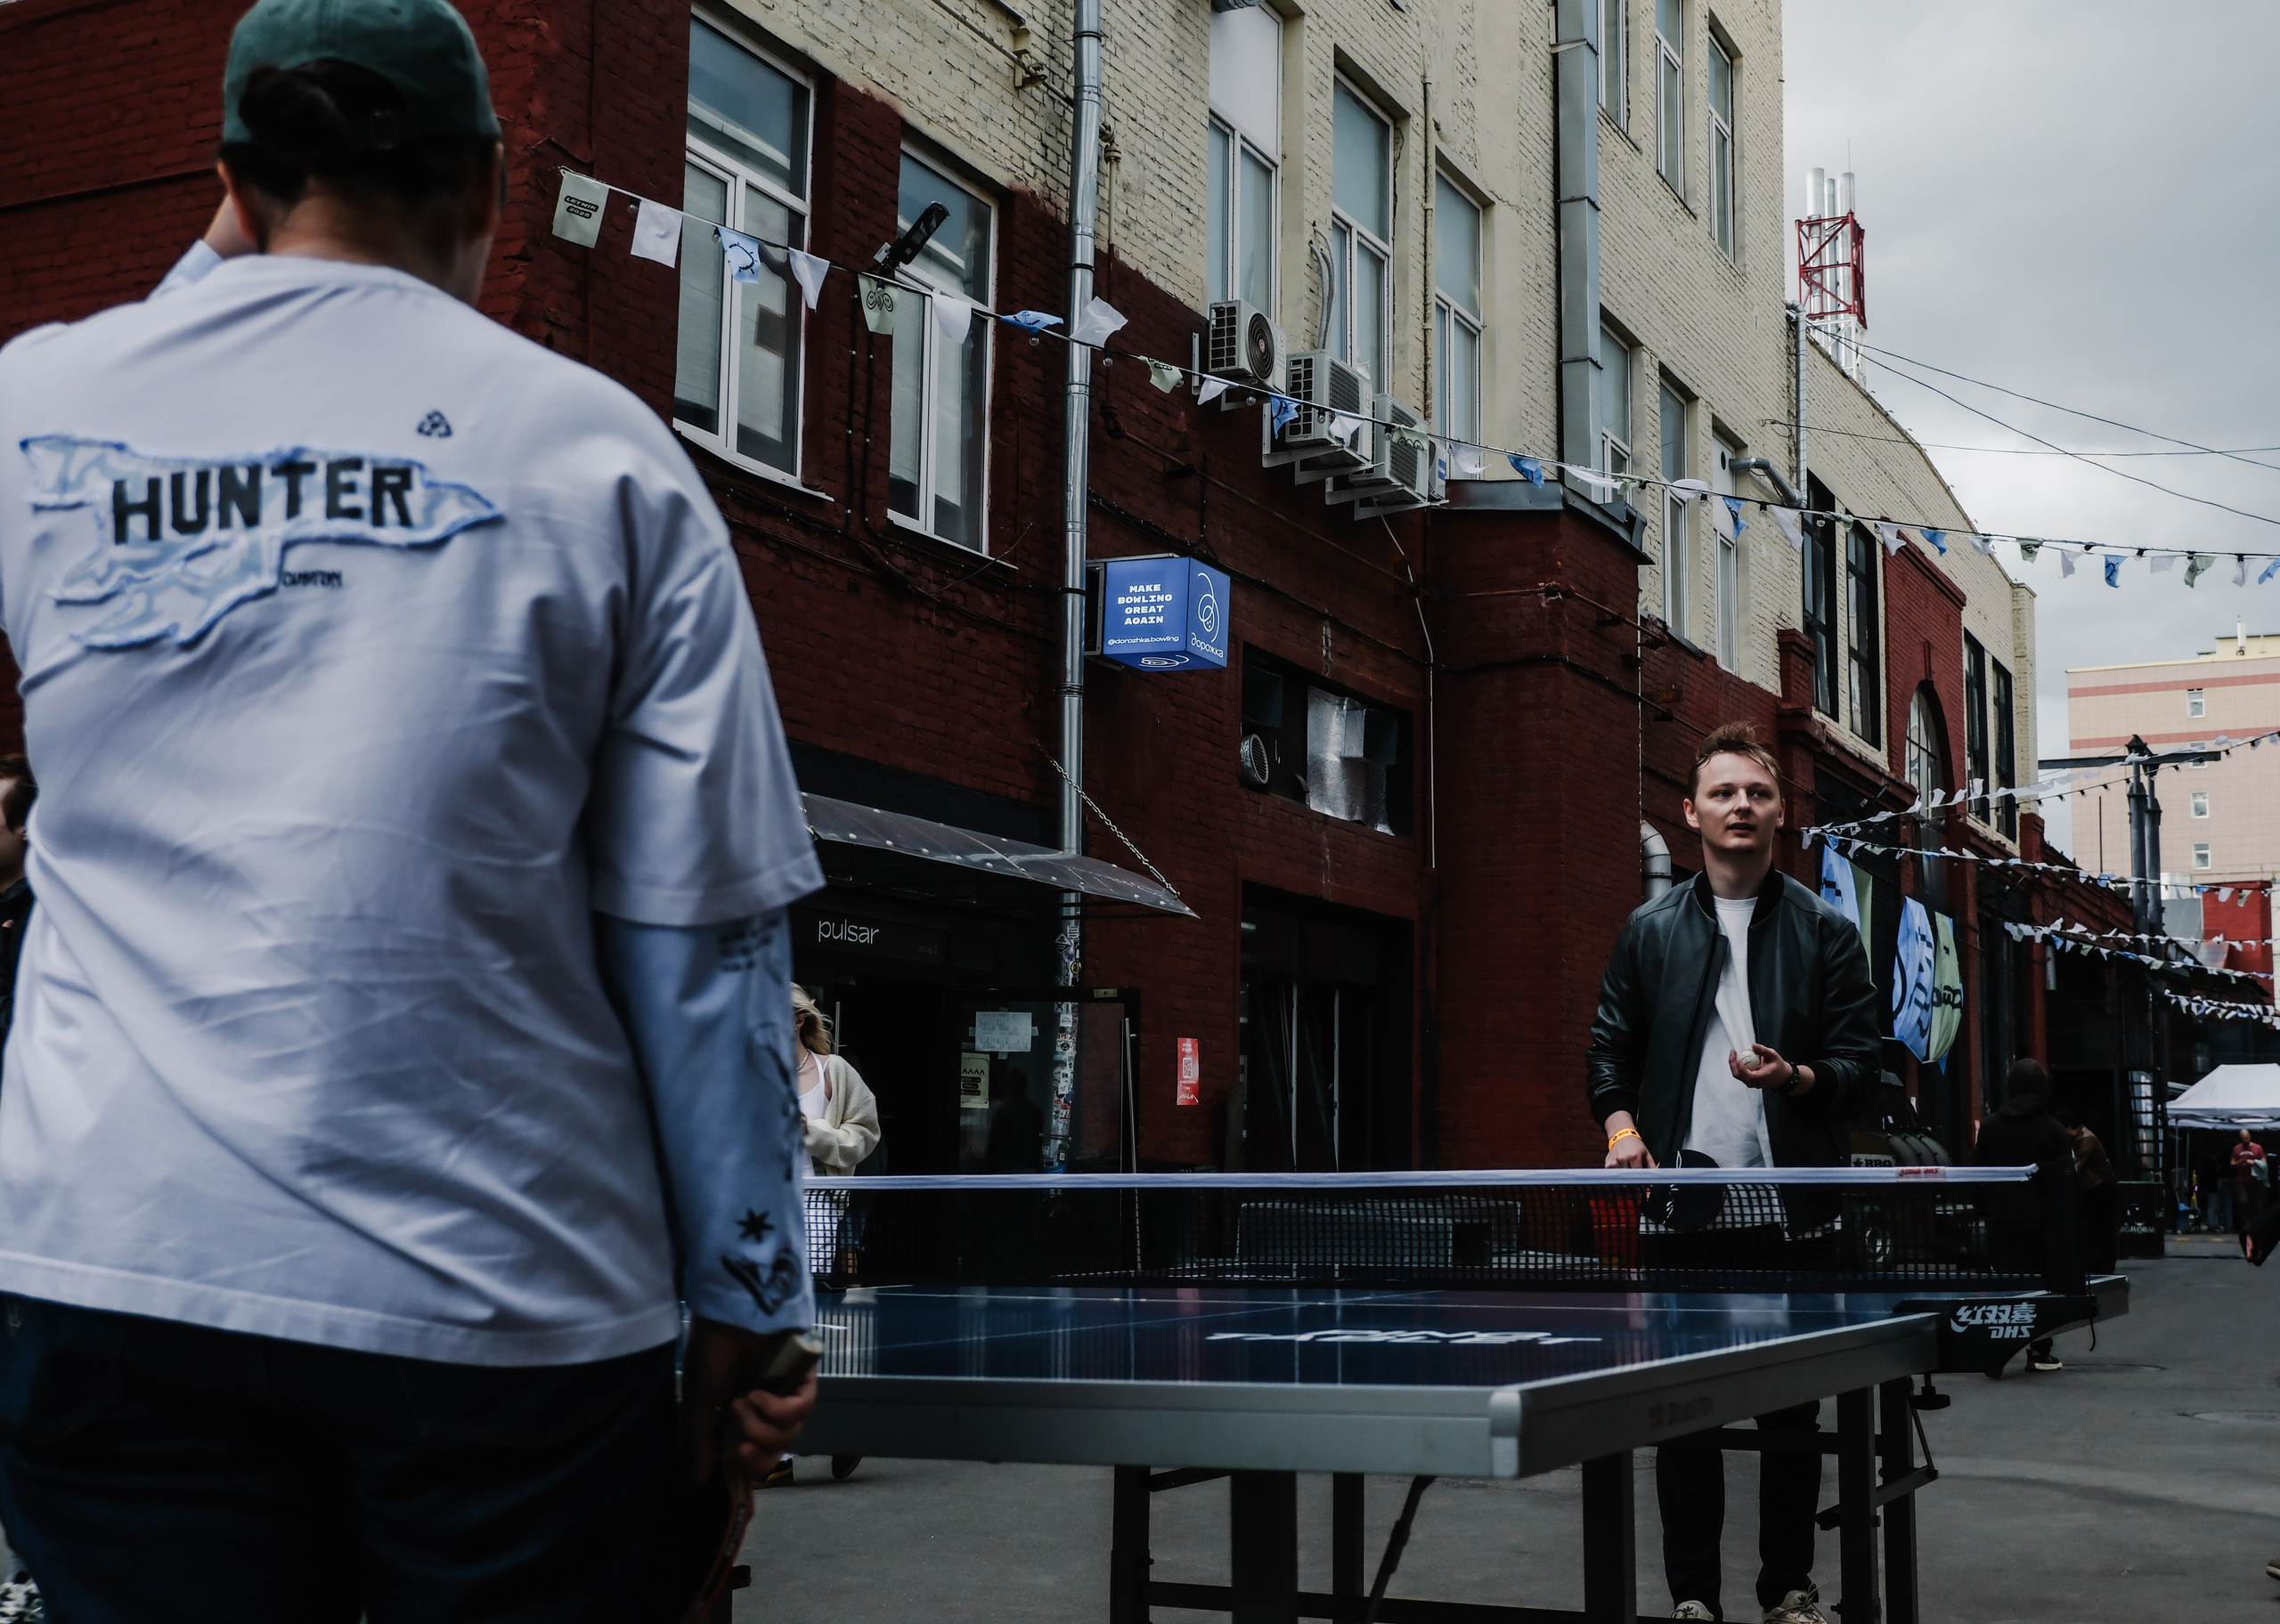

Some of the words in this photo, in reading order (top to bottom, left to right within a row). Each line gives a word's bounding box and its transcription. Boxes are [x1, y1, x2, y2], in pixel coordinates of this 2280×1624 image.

[566, 197, 598, 211] LETNIK
[113, 459, 412, 545] HUNTER
[1129, 584, 1161, 593] MAKE
[1118, 594, 1173, 605] BOWLING
[1125, 605, 1165, 614] GREAT
[1124, 616, 1164, 625] AGAIN
[1191, 632, 1224, 658] дорожка
[818, 918, 880, 945] pulsar
[1988, 1326, 2035, 1339] DHS
